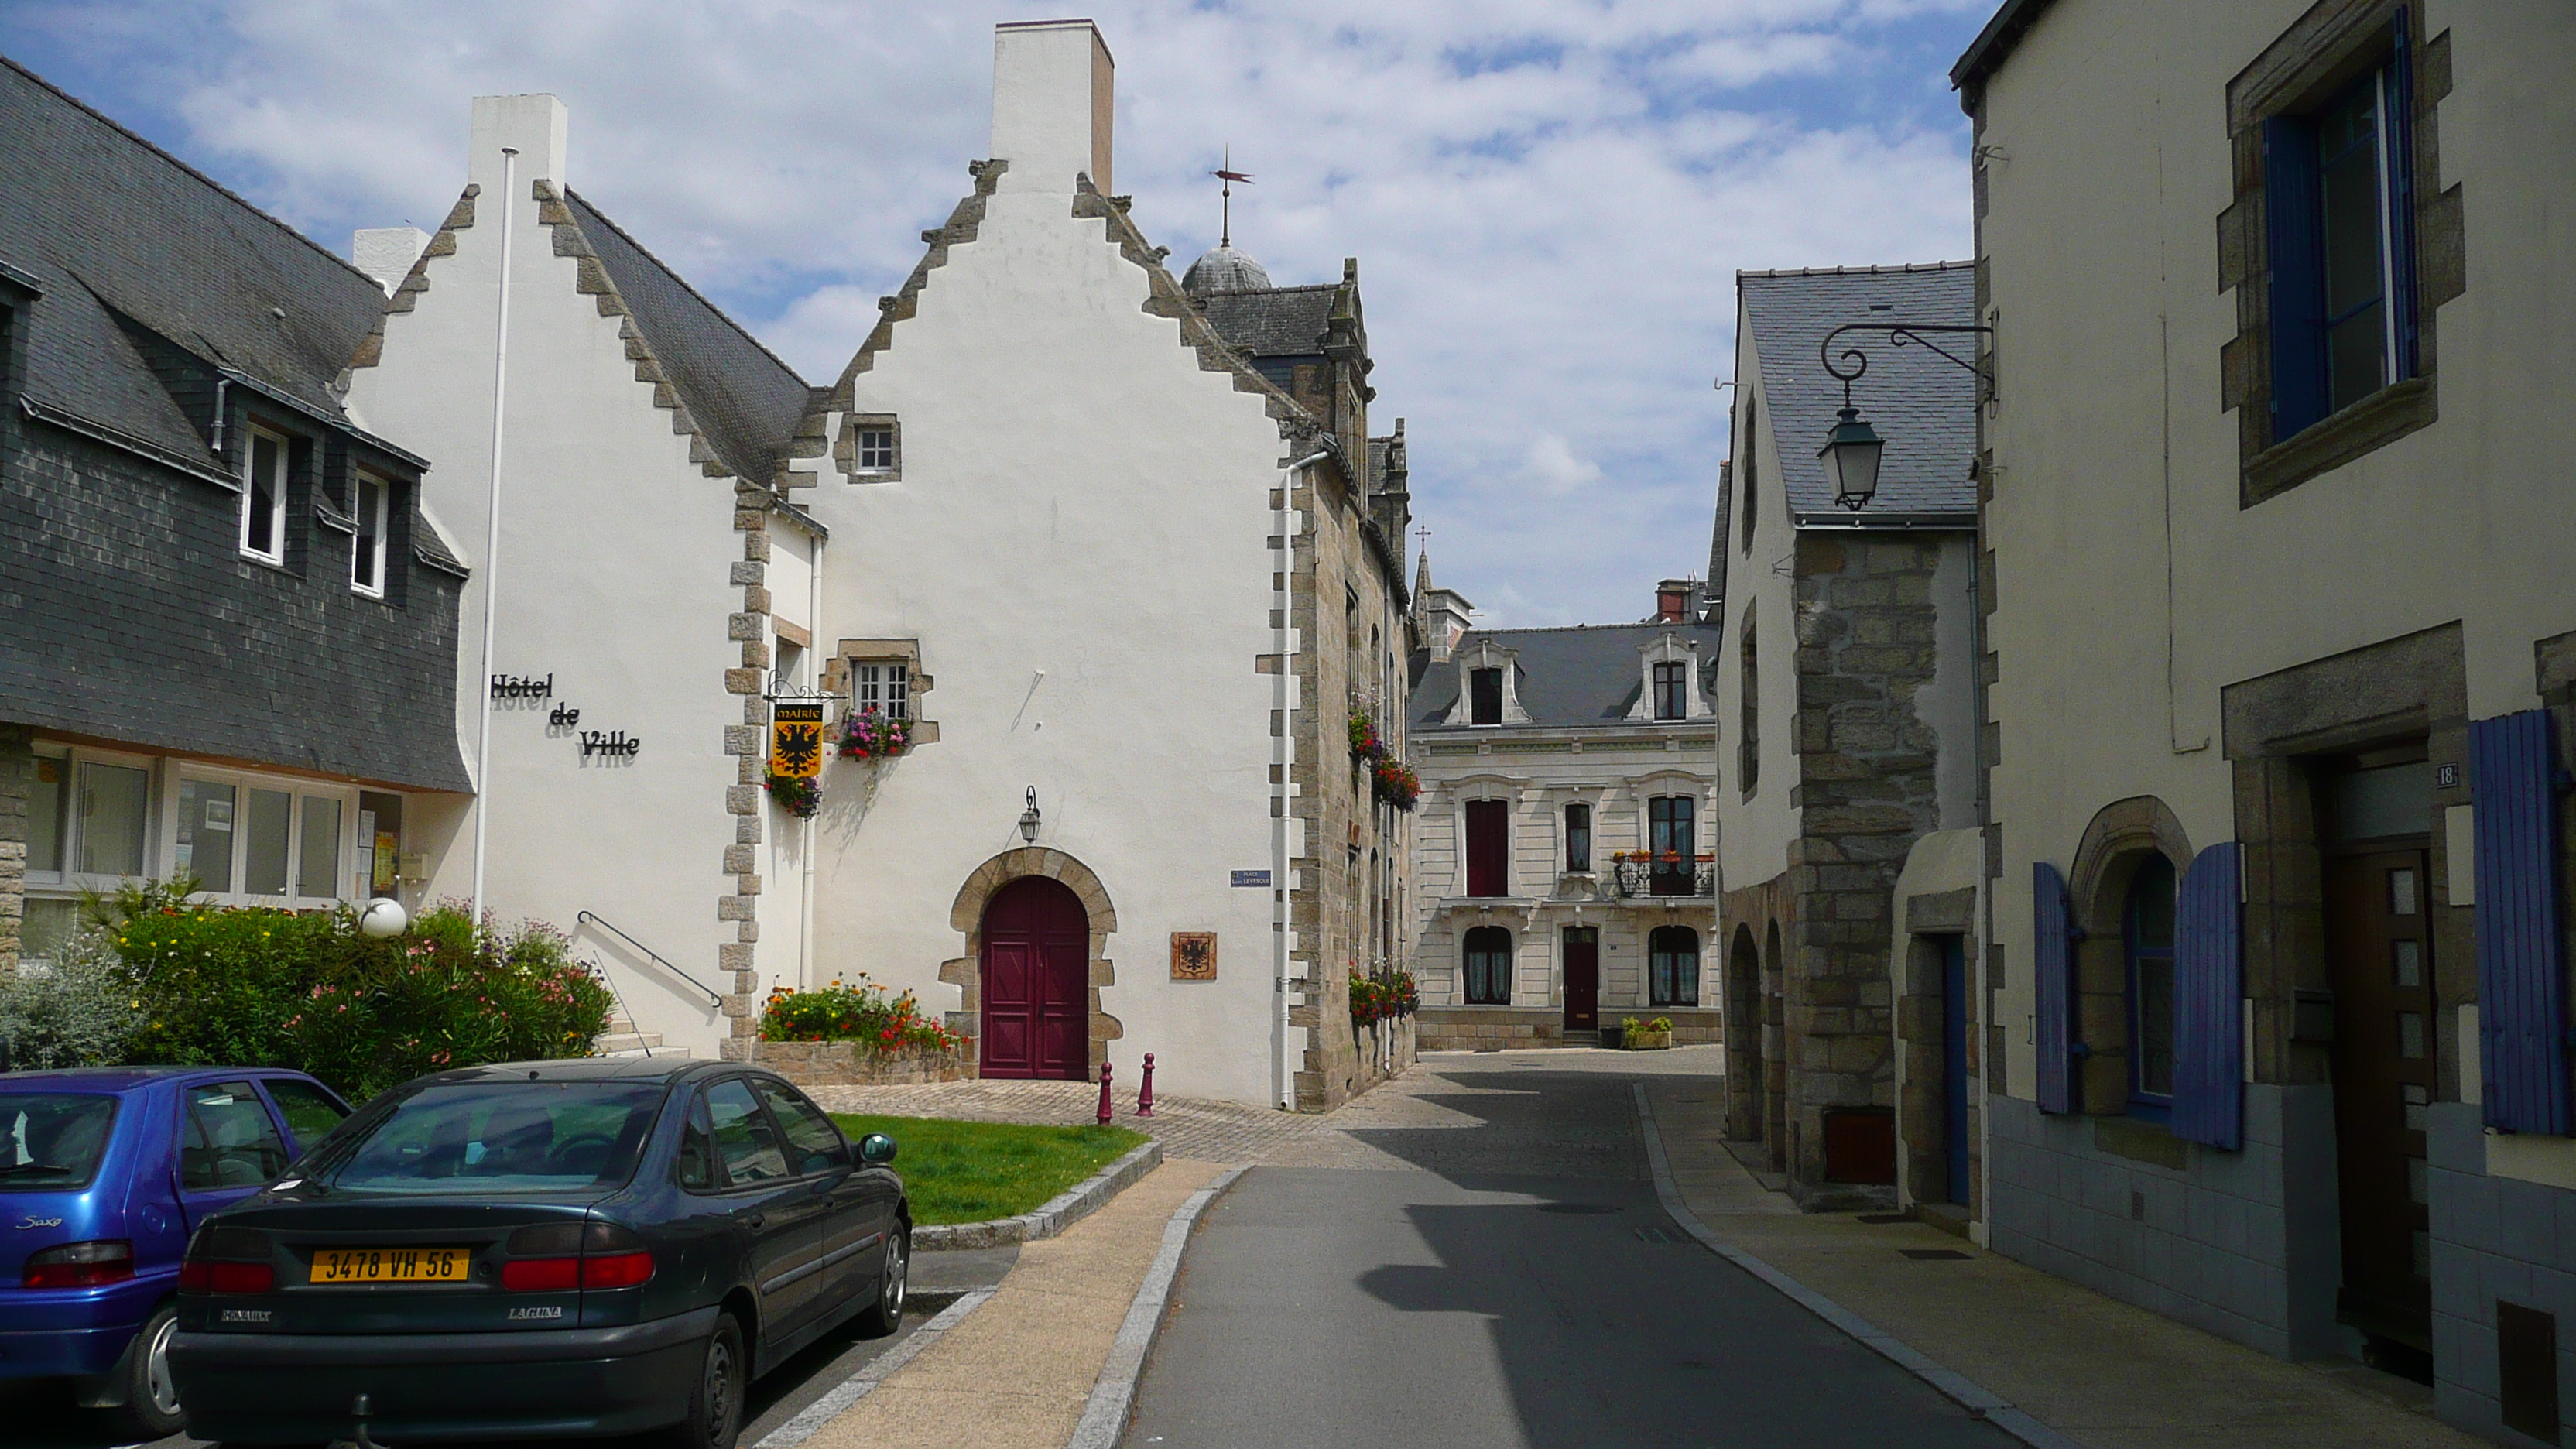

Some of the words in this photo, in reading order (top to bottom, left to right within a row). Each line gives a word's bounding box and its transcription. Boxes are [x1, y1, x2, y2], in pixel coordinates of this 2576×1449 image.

[491, 672, 553, 698] Hôtel
[550, 701, 580, 726] de
[777, 708, 820, 718] MAIRIE
[579, 730, 640, 756] Ville
[2440, 766, 2453, 784] 18
[15, 1215, 62, 1229] Saxo
[326, 1252, 381, 1279] 3478
[391, 1251, 418, 1277] VH
[426, 1251, 454, 1277] 56
[508, 1307, 562, 1320] LAGUNA
